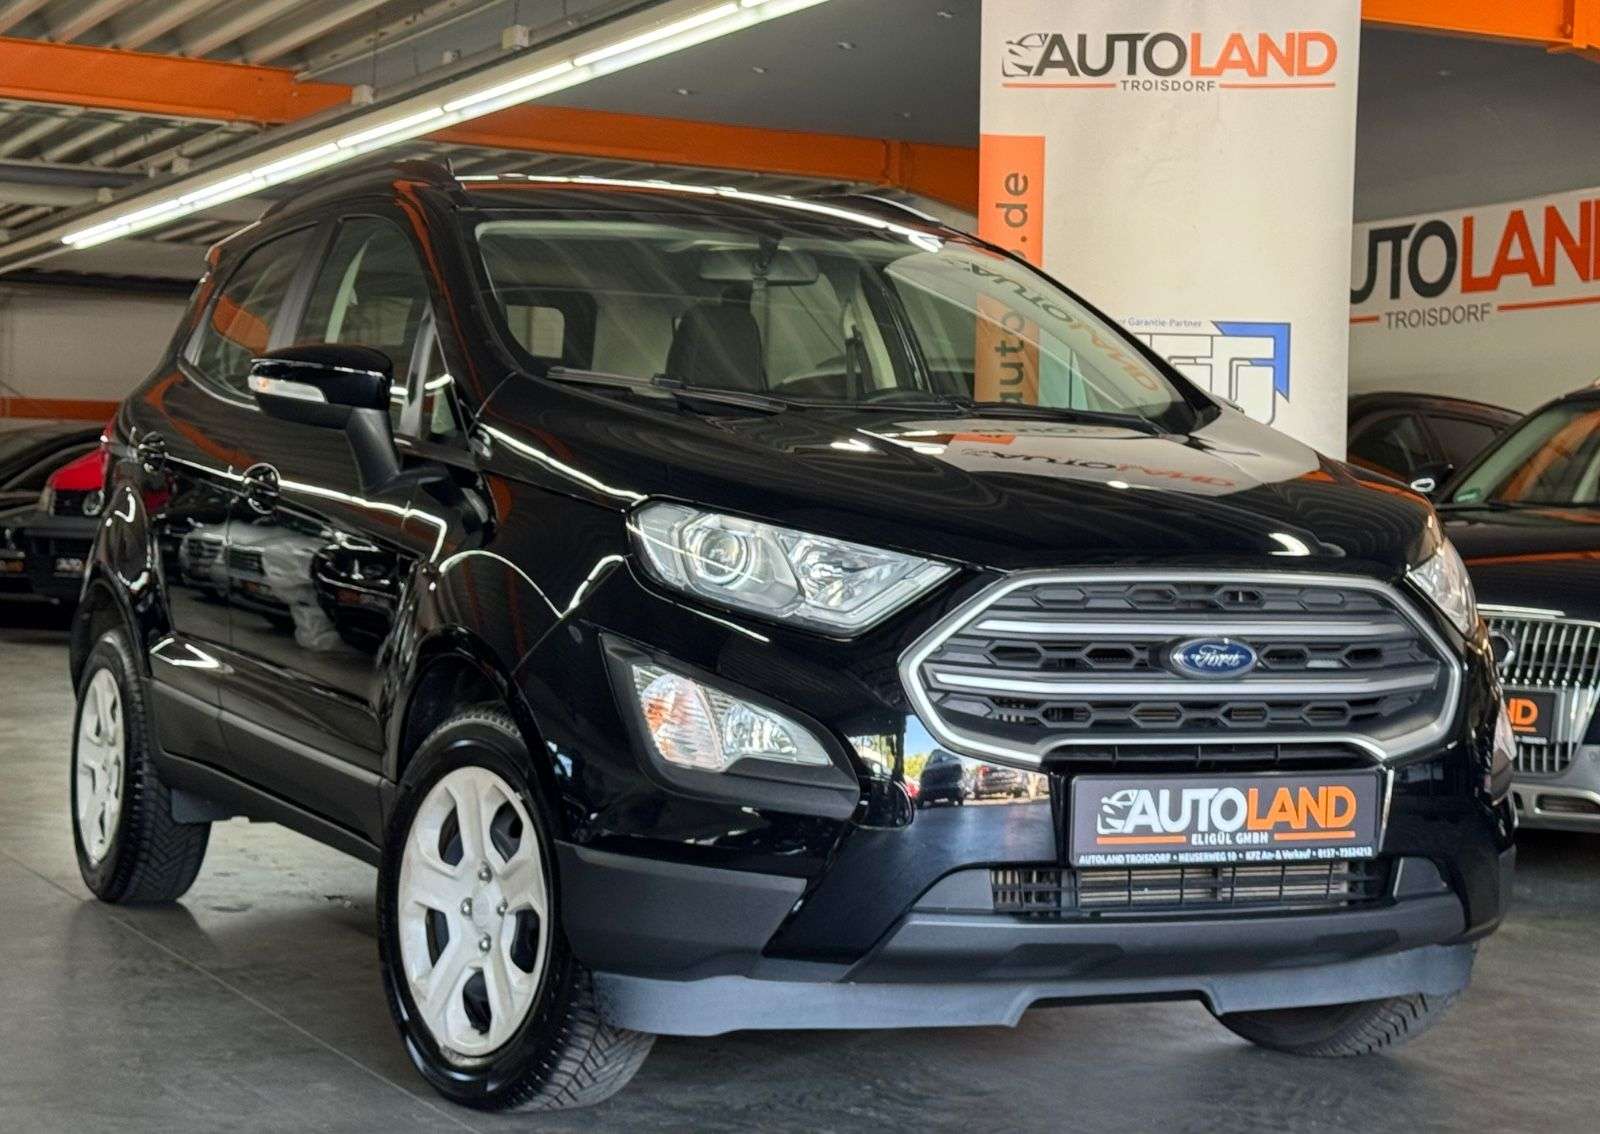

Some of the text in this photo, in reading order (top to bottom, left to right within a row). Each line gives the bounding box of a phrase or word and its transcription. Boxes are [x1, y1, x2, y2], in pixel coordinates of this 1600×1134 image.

[1033, 31, 1338, 77] AUTOLAND
[1120, 79, 1217, 92] TROISDORF
[1350, 198, 1600, 304] UTOLAN
[1385, 302, 1492, 330] TROISDORF
[1190, 643, 1247, 667] Ford
[1122, 786, 1357, 833] AUTOLAND
[1191, 832, 1232, 846] ELIGÜL
